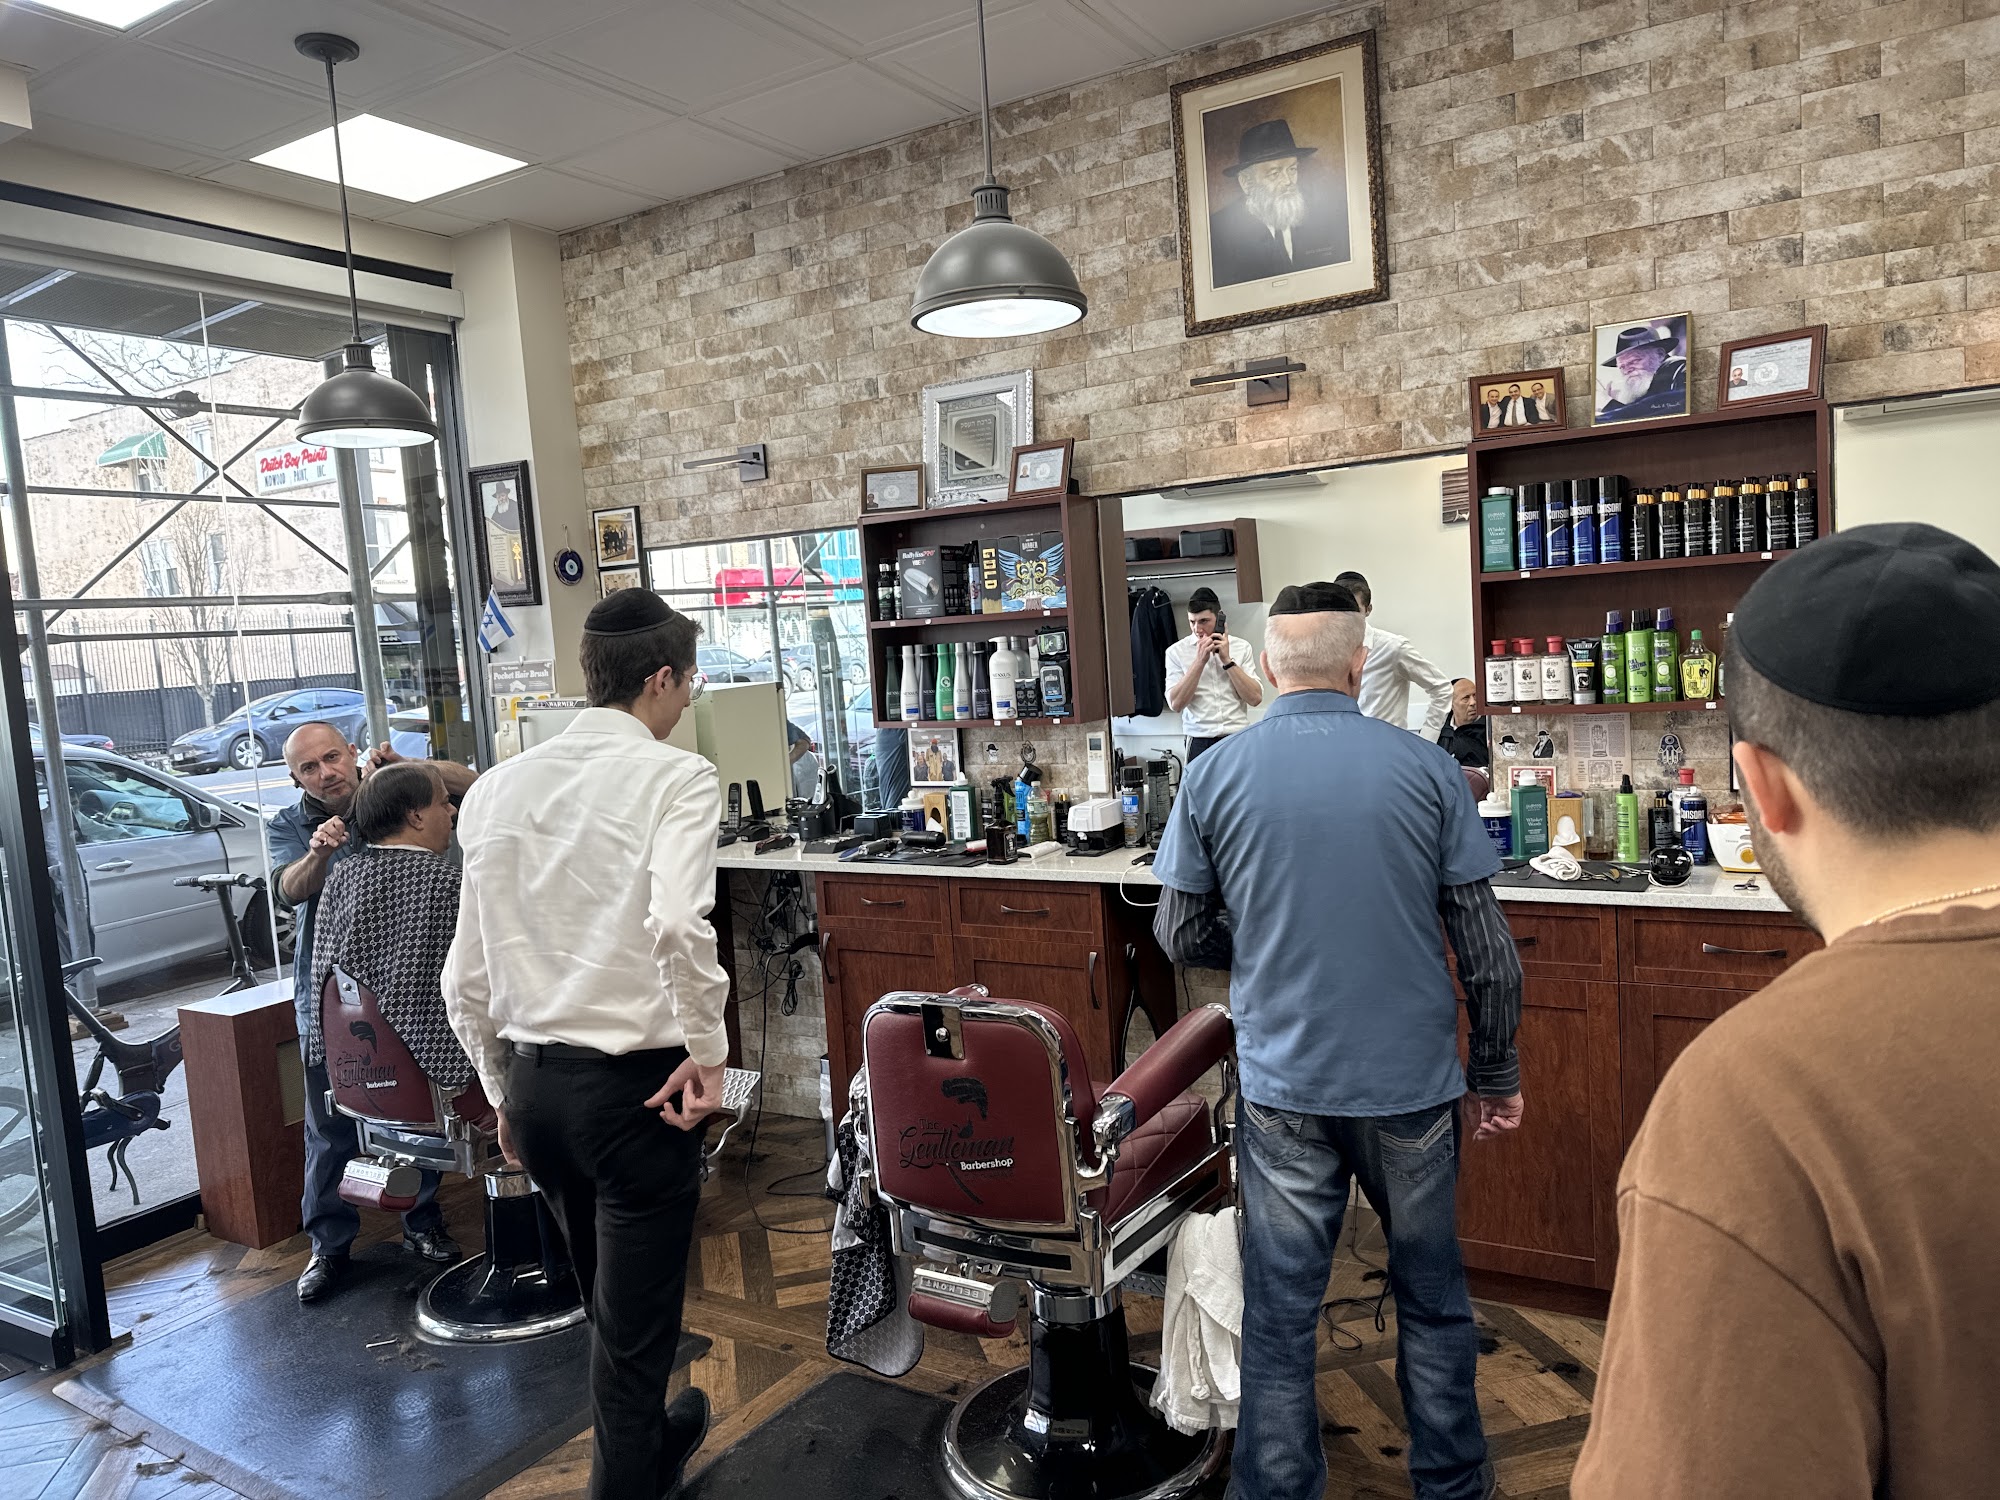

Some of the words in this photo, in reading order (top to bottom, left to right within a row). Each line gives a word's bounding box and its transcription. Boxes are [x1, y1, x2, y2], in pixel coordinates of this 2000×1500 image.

[260, 456, 283, 473] Dutch
[284, 452, 300, 469] Boy
[301, 447, 328, 465] Paints
[982, 548, 998, 590] GOLD
[493, 672, 514, 680] Pocket
[515, 670, 529, 679] Hair
[530, 669, 549, 678] Brush
[366, 1080, 398, 1089] Barbershop
[919, 1118, 939, 1130] The
[898, 1126, 1014, 1169] Gentleman
[960, 1158, 1014, 1170] Barbershop
[925, 1280, 979, 1298] BELMONT
